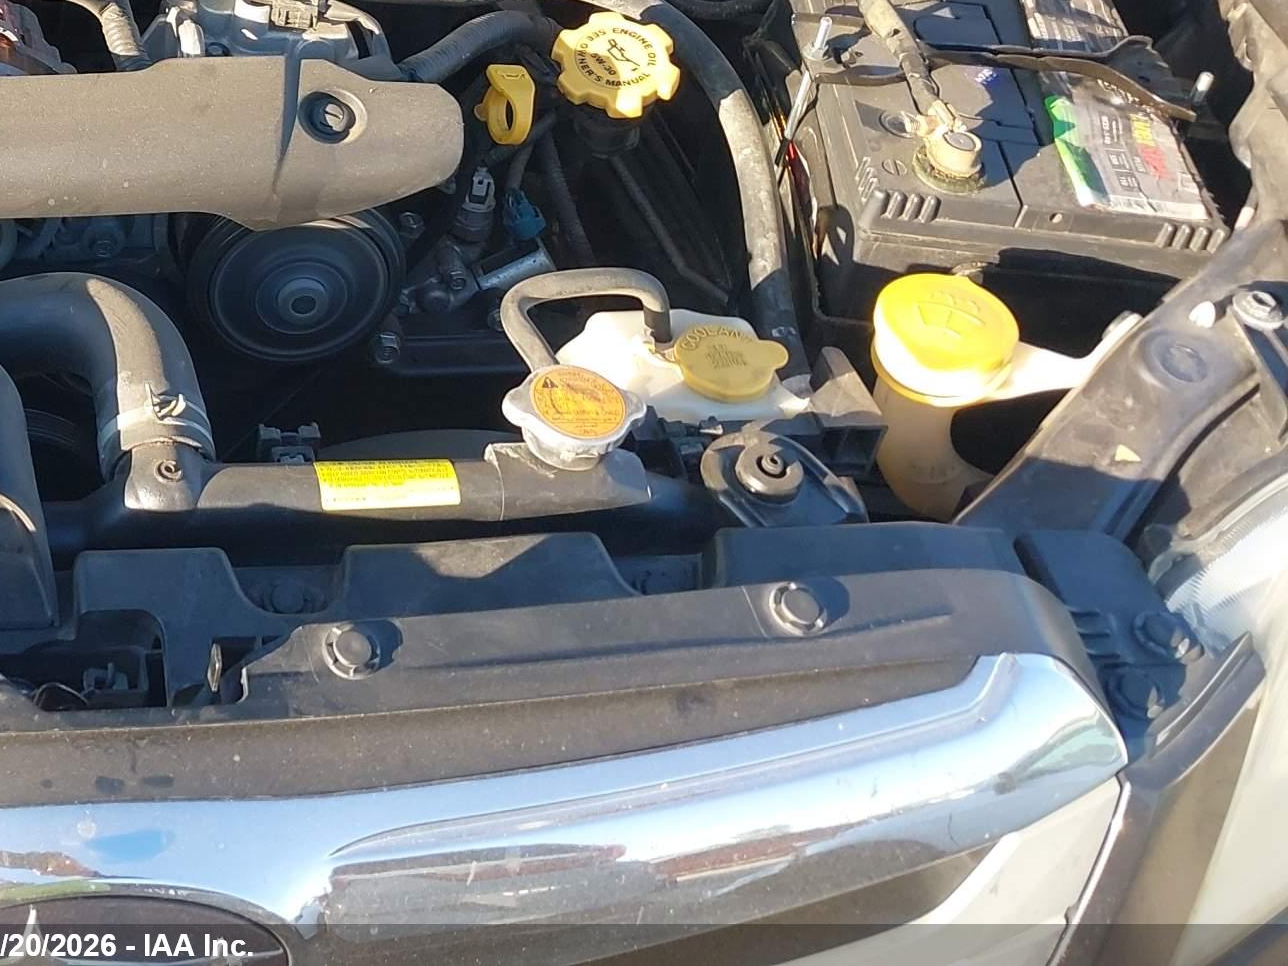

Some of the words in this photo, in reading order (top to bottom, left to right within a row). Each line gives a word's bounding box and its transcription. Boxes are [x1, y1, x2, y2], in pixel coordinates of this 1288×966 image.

[586, 29, 606, 41] SEE
[613, 28, 653, 49] ENGINE
[647, 52, 656, 66] OIL
[577, 44, 602, 82] OWNER'S
[605, 73, 651, 86] MANUAL
